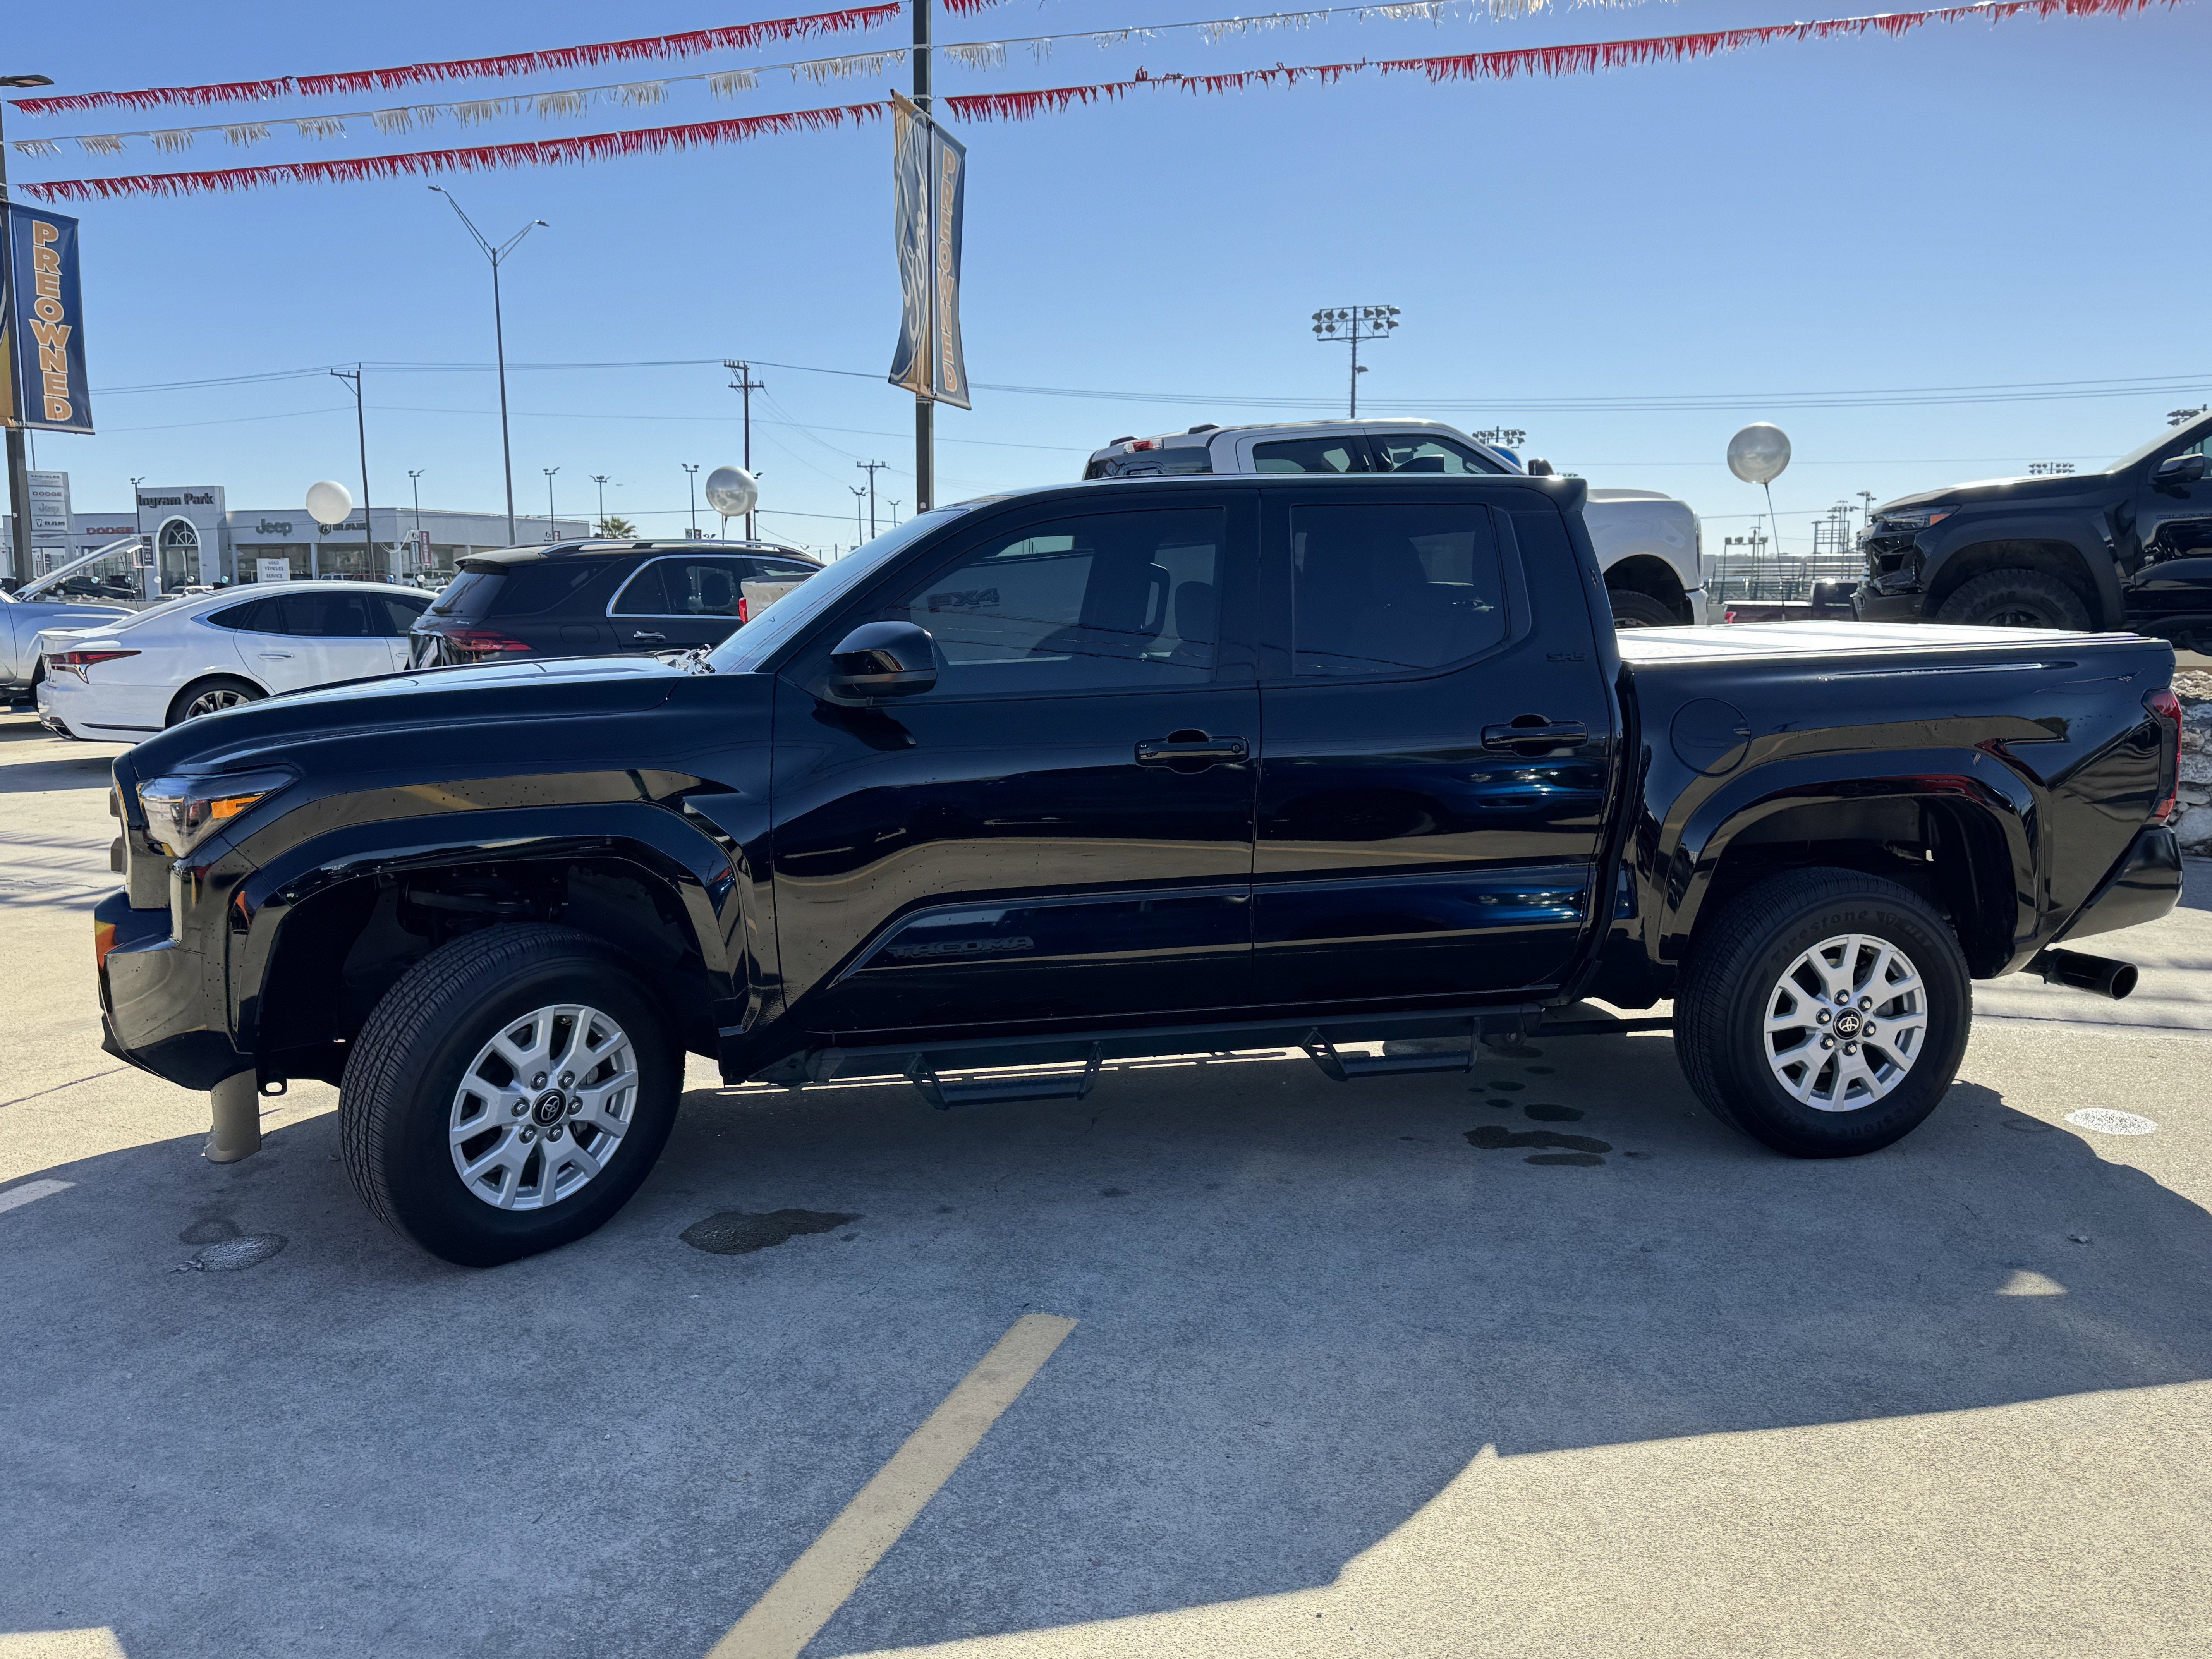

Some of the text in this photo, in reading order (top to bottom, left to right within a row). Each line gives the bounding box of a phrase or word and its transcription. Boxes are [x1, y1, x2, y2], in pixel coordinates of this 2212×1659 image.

[936, 144, 957, 393] PREOWNED
[29, 219, 72, 421] PREOWNED
[137, 492, 214, 508] Ingram Park
[86, 527, 134, 535] DODGE
[256, 519, 292, 537] Jeep
[927, 587, 1000, 613] FX4
[885, 936, 1035, 958] TACOMA
[1771, 910, 1869, 964] Firestone
